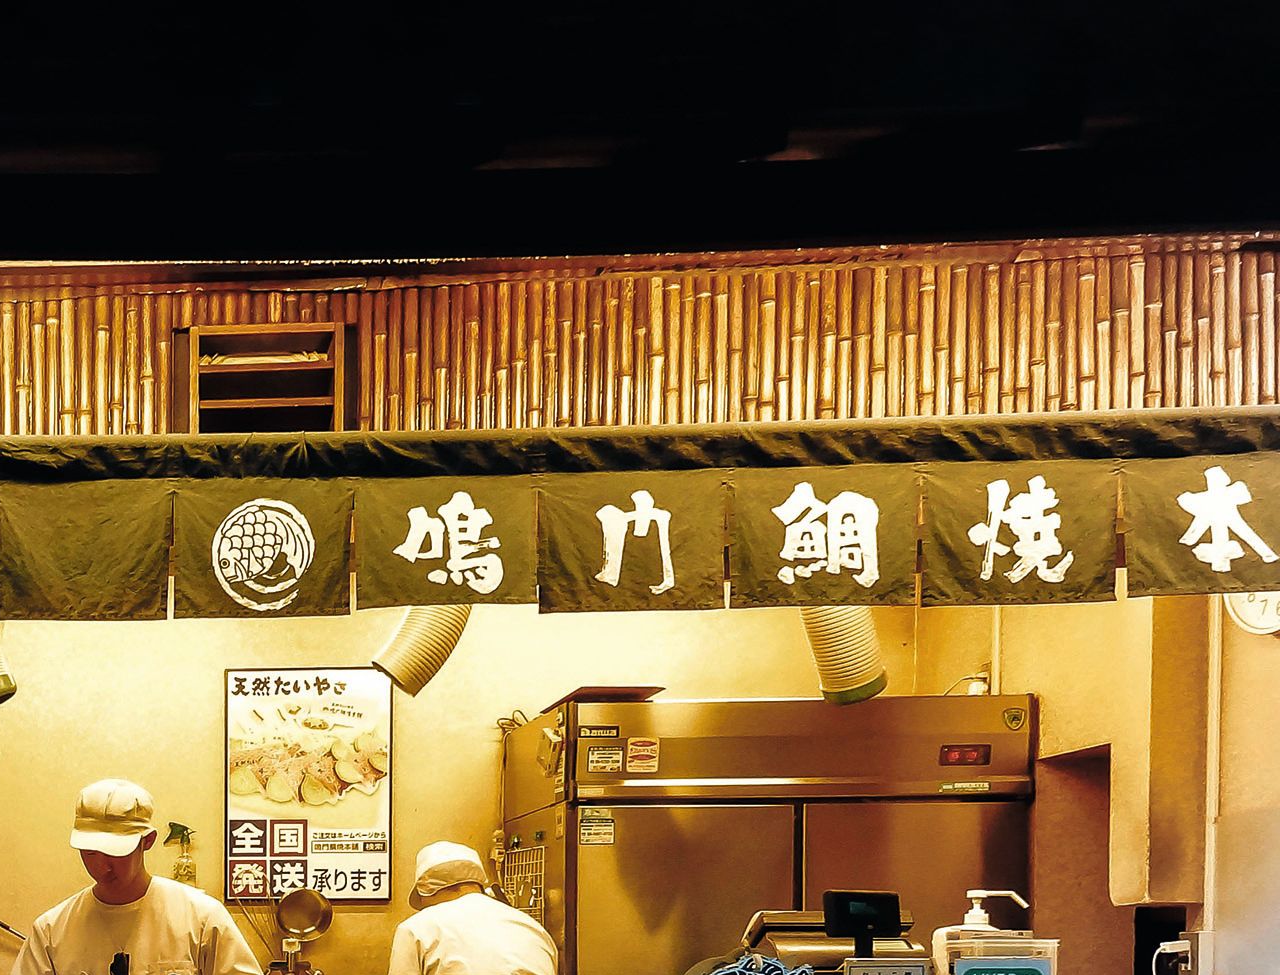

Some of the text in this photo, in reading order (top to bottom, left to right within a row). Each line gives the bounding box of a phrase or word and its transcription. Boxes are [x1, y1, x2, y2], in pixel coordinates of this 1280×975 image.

[231, 822, 304, 855] 全国
[231, 863, 304, 896] 発送
[312, 868, 387, 892] 承ります
